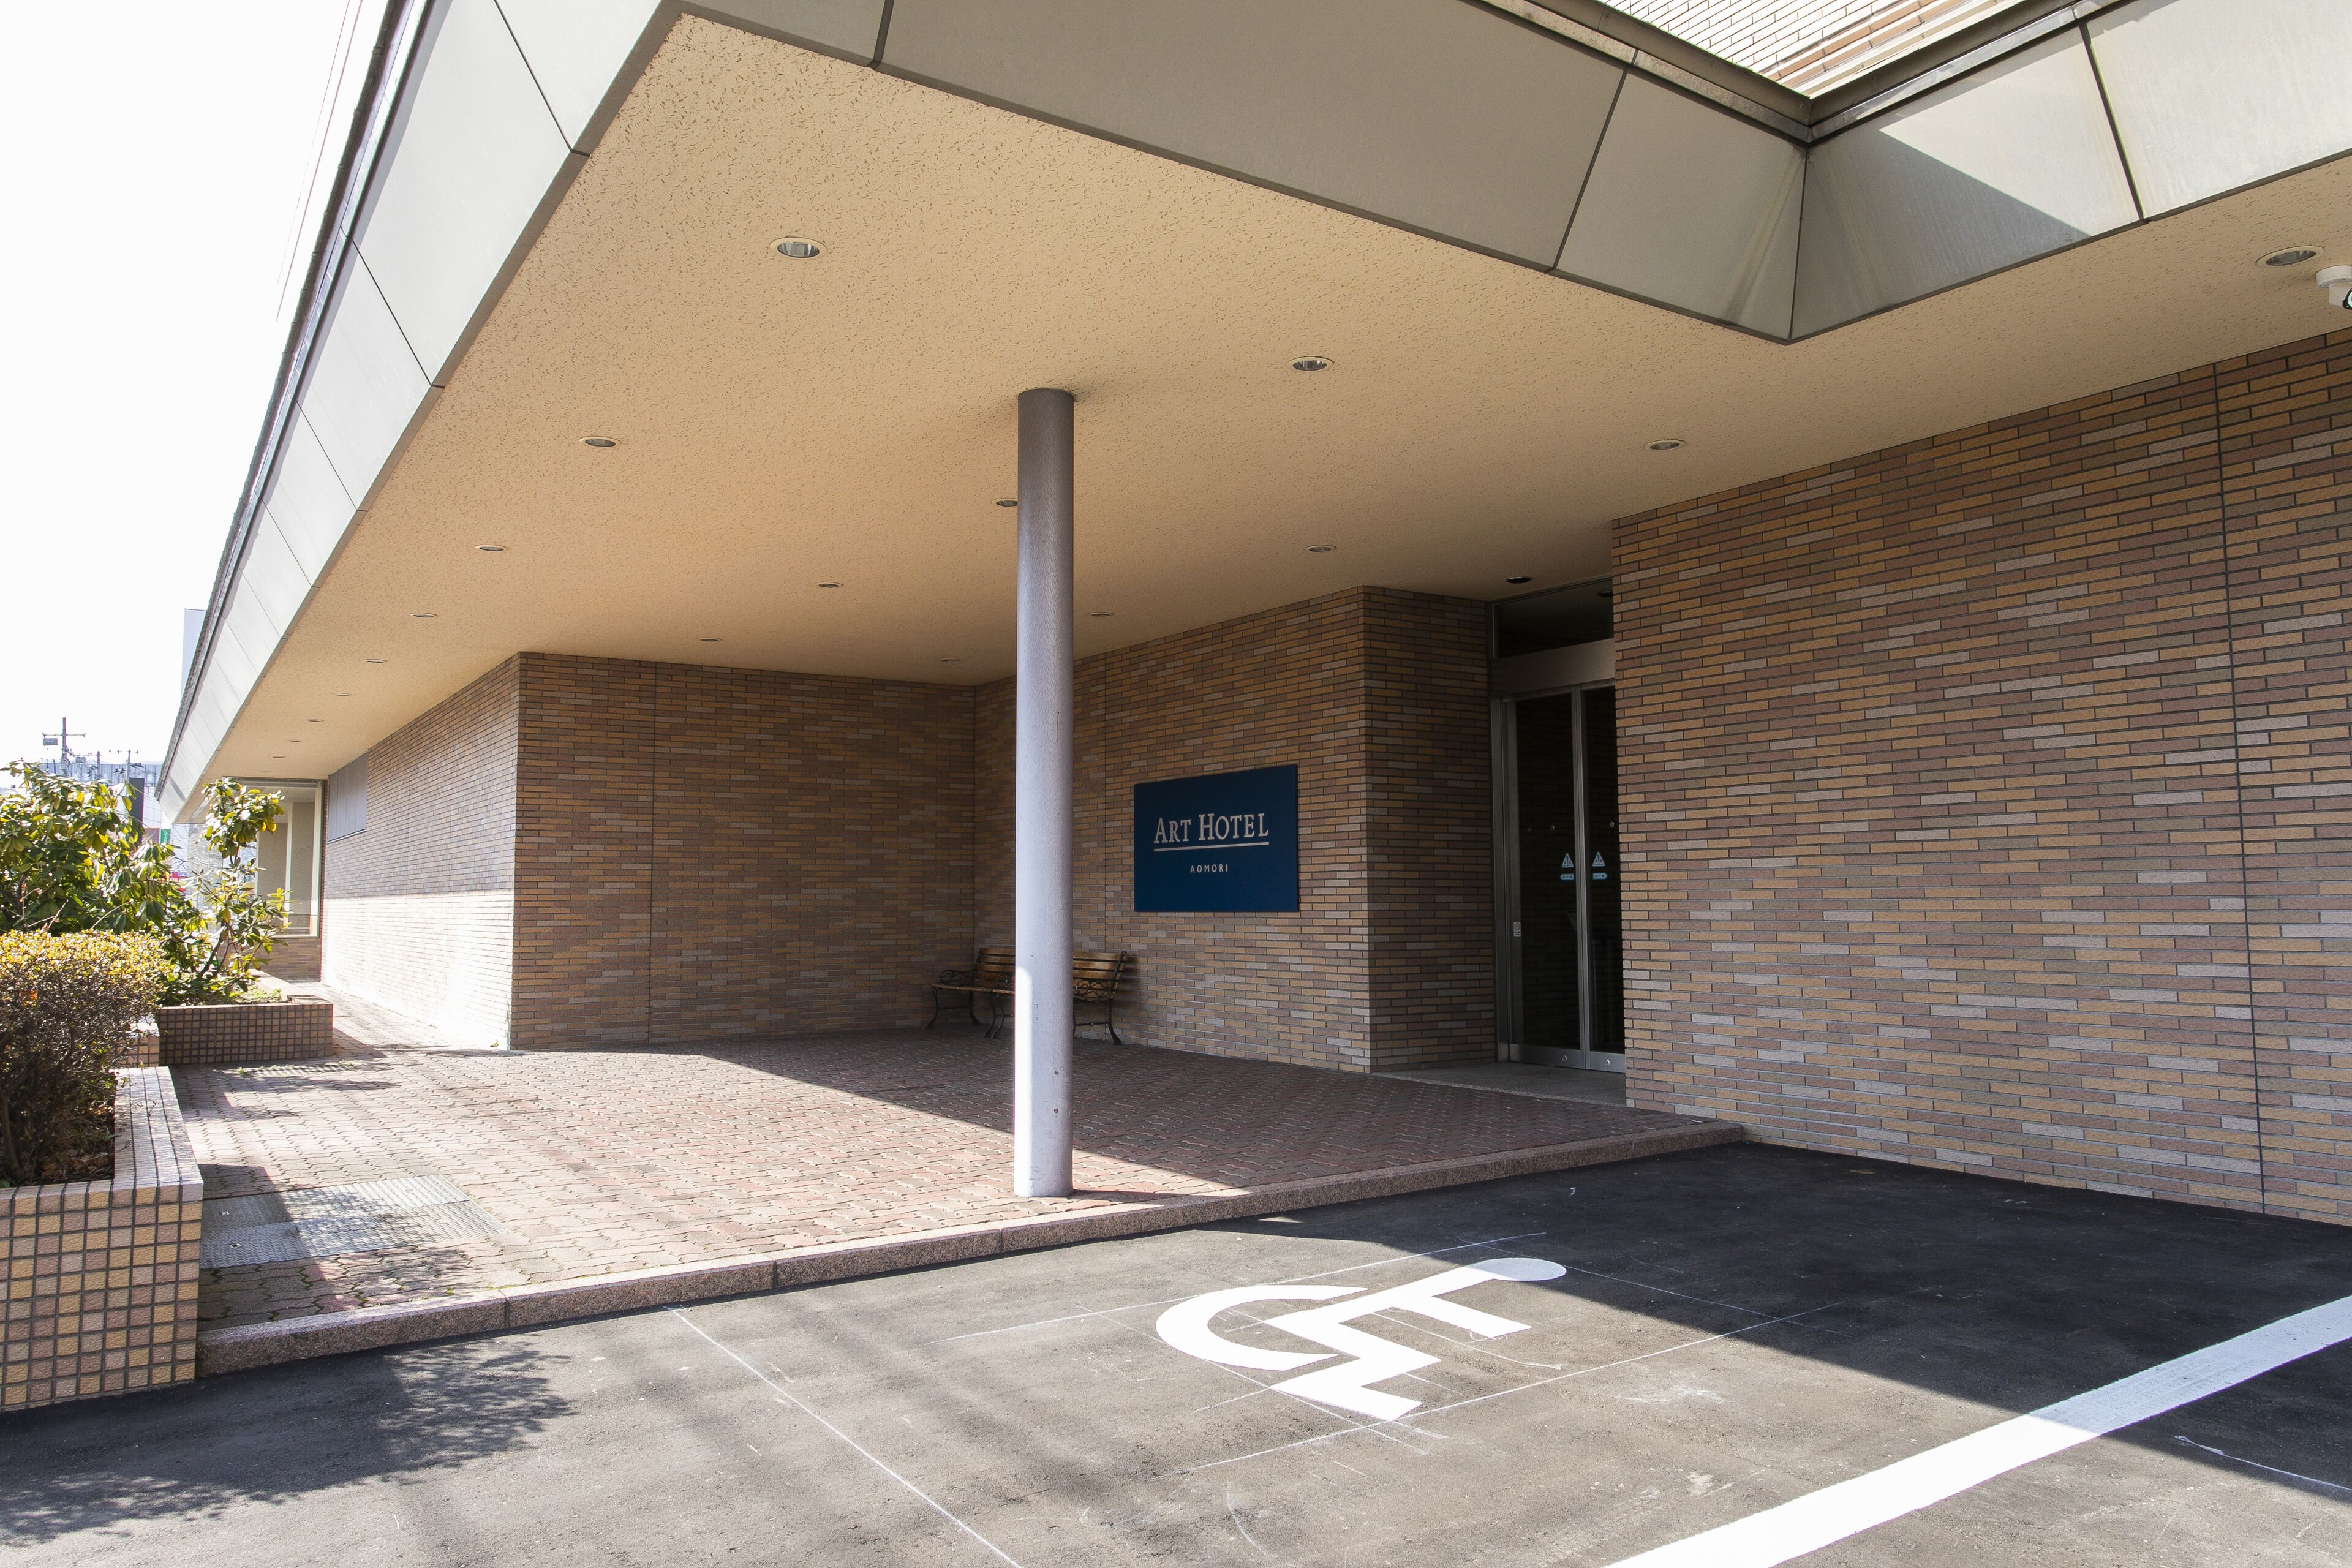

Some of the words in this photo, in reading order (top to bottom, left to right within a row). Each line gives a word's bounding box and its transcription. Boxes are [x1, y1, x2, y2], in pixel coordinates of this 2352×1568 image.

[1153, 818, 1191, 844] ART
[1198, 813, 1269, 841] HOTEL
[1190, 864, 1228, 873] AOMORI
